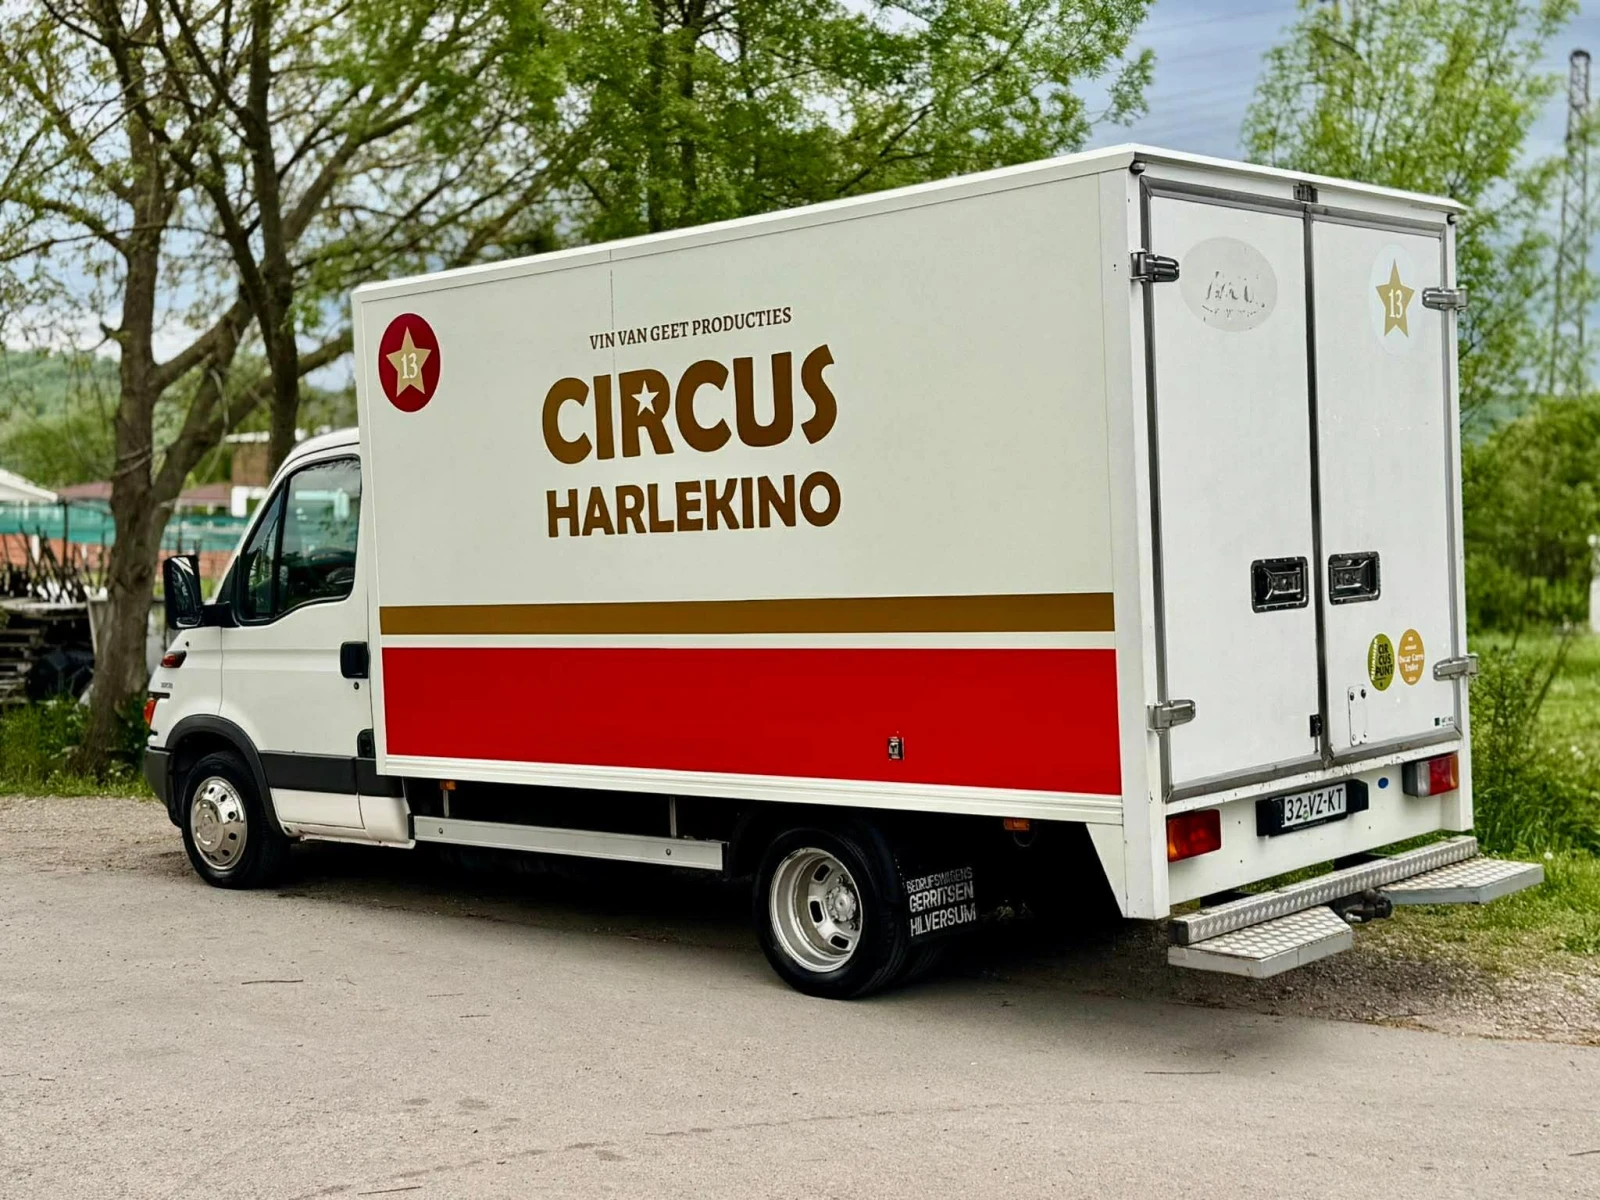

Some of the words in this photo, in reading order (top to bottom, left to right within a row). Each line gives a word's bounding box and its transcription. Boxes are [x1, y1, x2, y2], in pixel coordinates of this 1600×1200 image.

[1388, 288, 1404, 319] 13
[589, 331, 616, 351] VIN
[618, 327, 648, 346] VAN
[650, 321, 689, 342] GEET
[692, 306, 792, 335] PRODUCTIES
[401, 352, 418, 379] 13
[542, 344, 838, 464] CIRCUS
[546, 471, 841, 538] HARLEKINO
[1286, 788, 1343, 821] 32-VZ-KT
[909, 880, 974, 913] GERRITSEN
[910, 902, 977, 937] HILVERSUM
